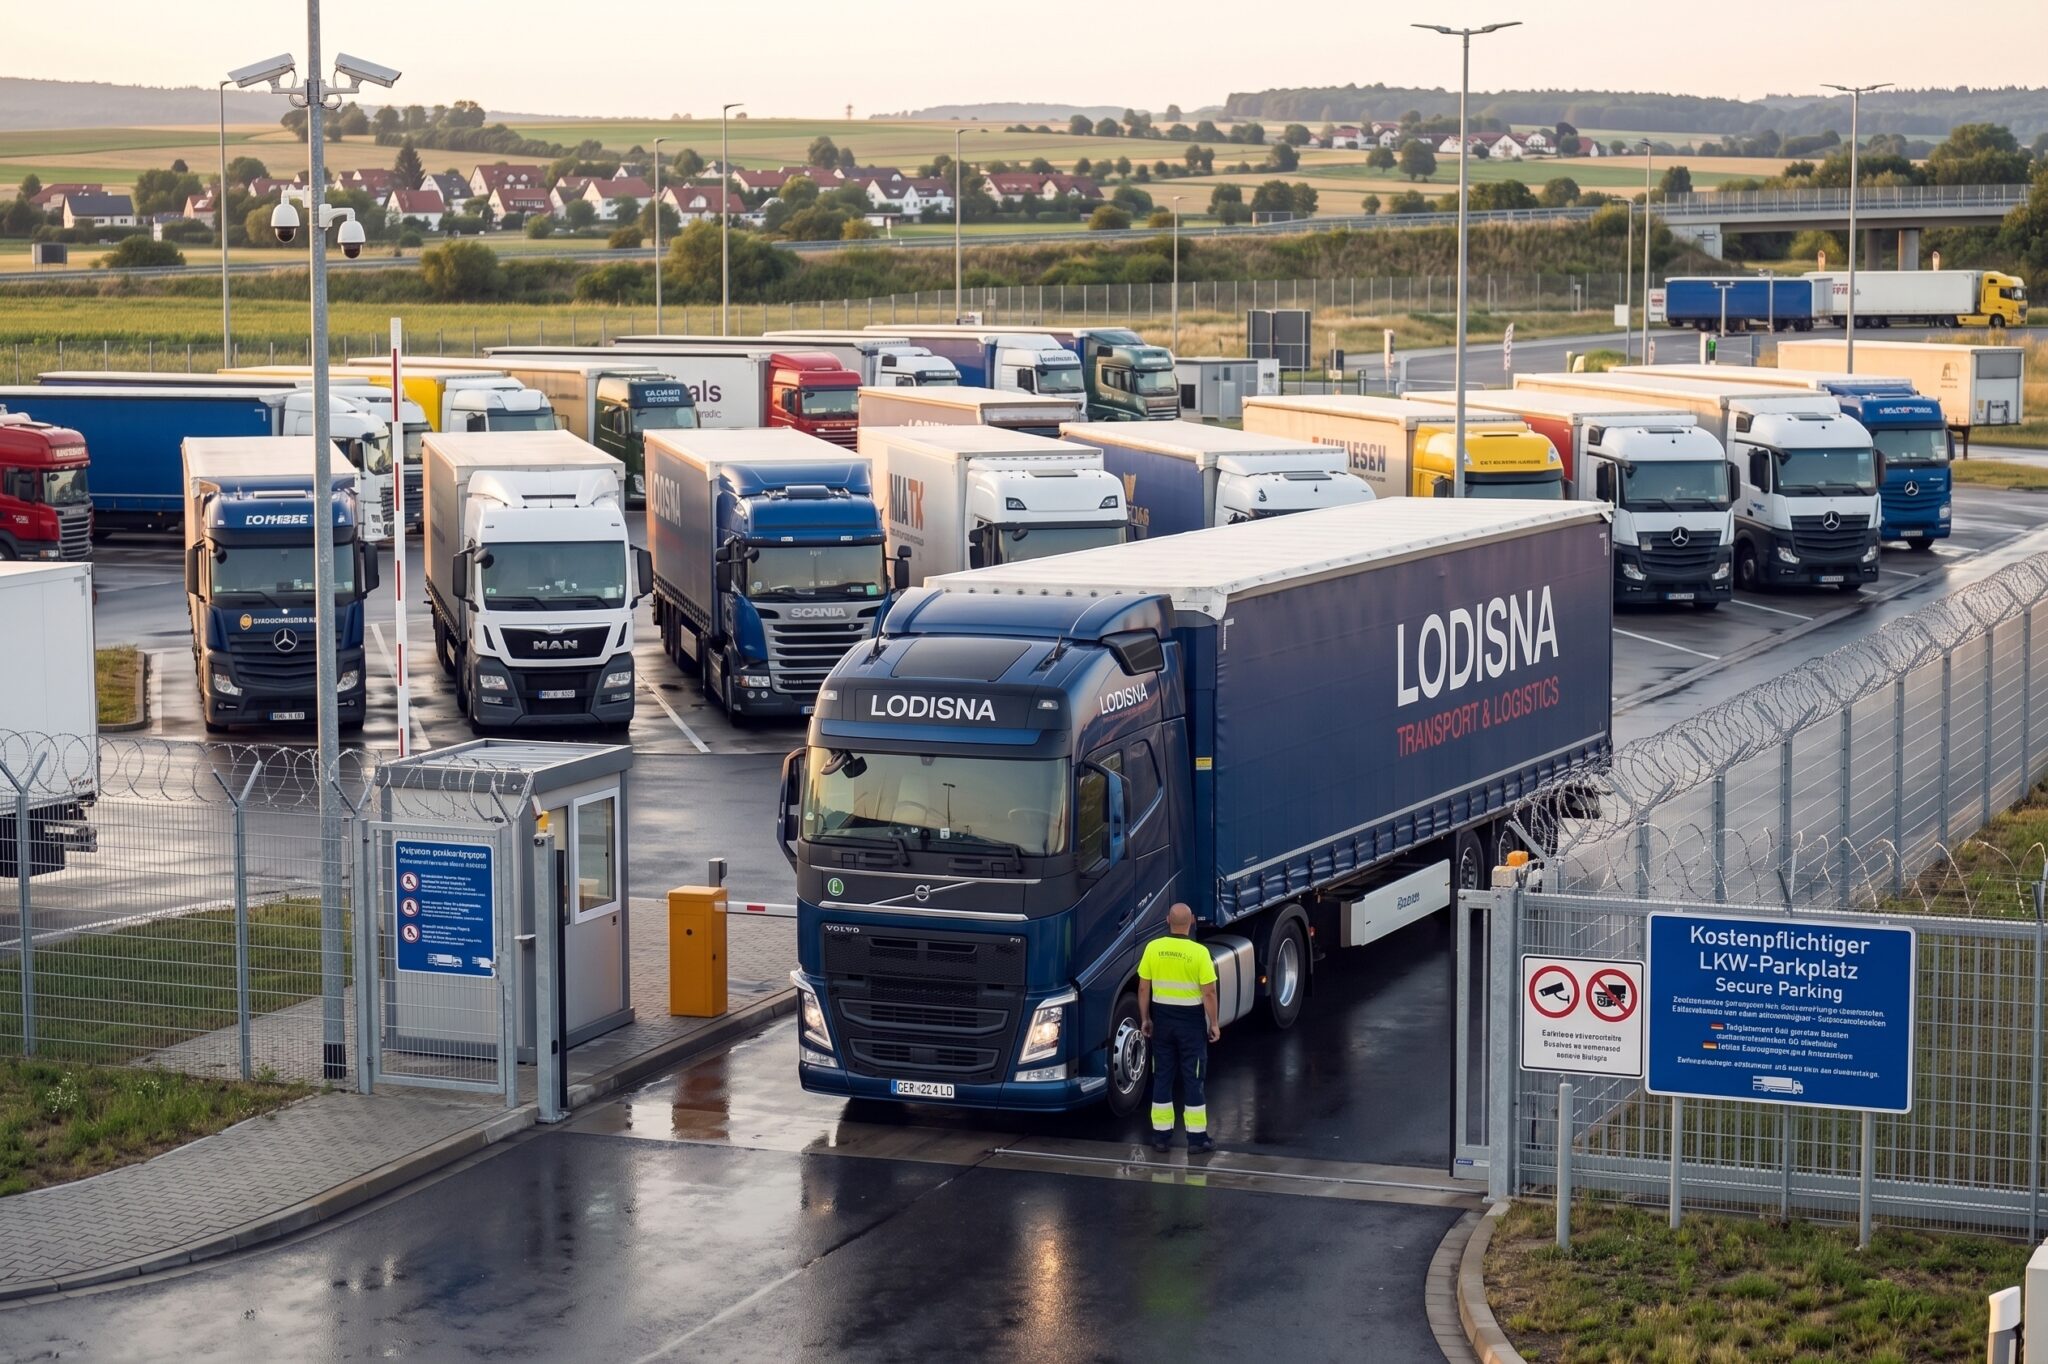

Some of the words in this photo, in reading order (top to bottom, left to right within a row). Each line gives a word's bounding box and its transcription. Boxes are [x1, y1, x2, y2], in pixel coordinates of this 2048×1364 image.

[791, 607, 846, 618] SCANIA
[533, 640, 578, 650] MAN
[1397, 585, 1559, 708] LODISNA
[870, 694, 996, 721] LODISNA
[1100, 683, 1149, 715] LODISNA
[1397, 702, 1479, 758] TRANSPORT
[1482, 699, 1491, 728] &
[1495, 675, 1560, 725] LOGISTICS
[826, 925, 860, 933] VOLVO
[1690, 925, 1870, 957] Kostenpflichtiger
[1700, 951, 1859, 981] LKW-Parkplatz
[1715, 977, 1773, 995] Secure
[1778, 981, 1843, 1003] Parking
[897, 1082, 915, 1093] GER
[921, 1084, 938, 1095] 224
[940, 1085, 953, 1096] LD
